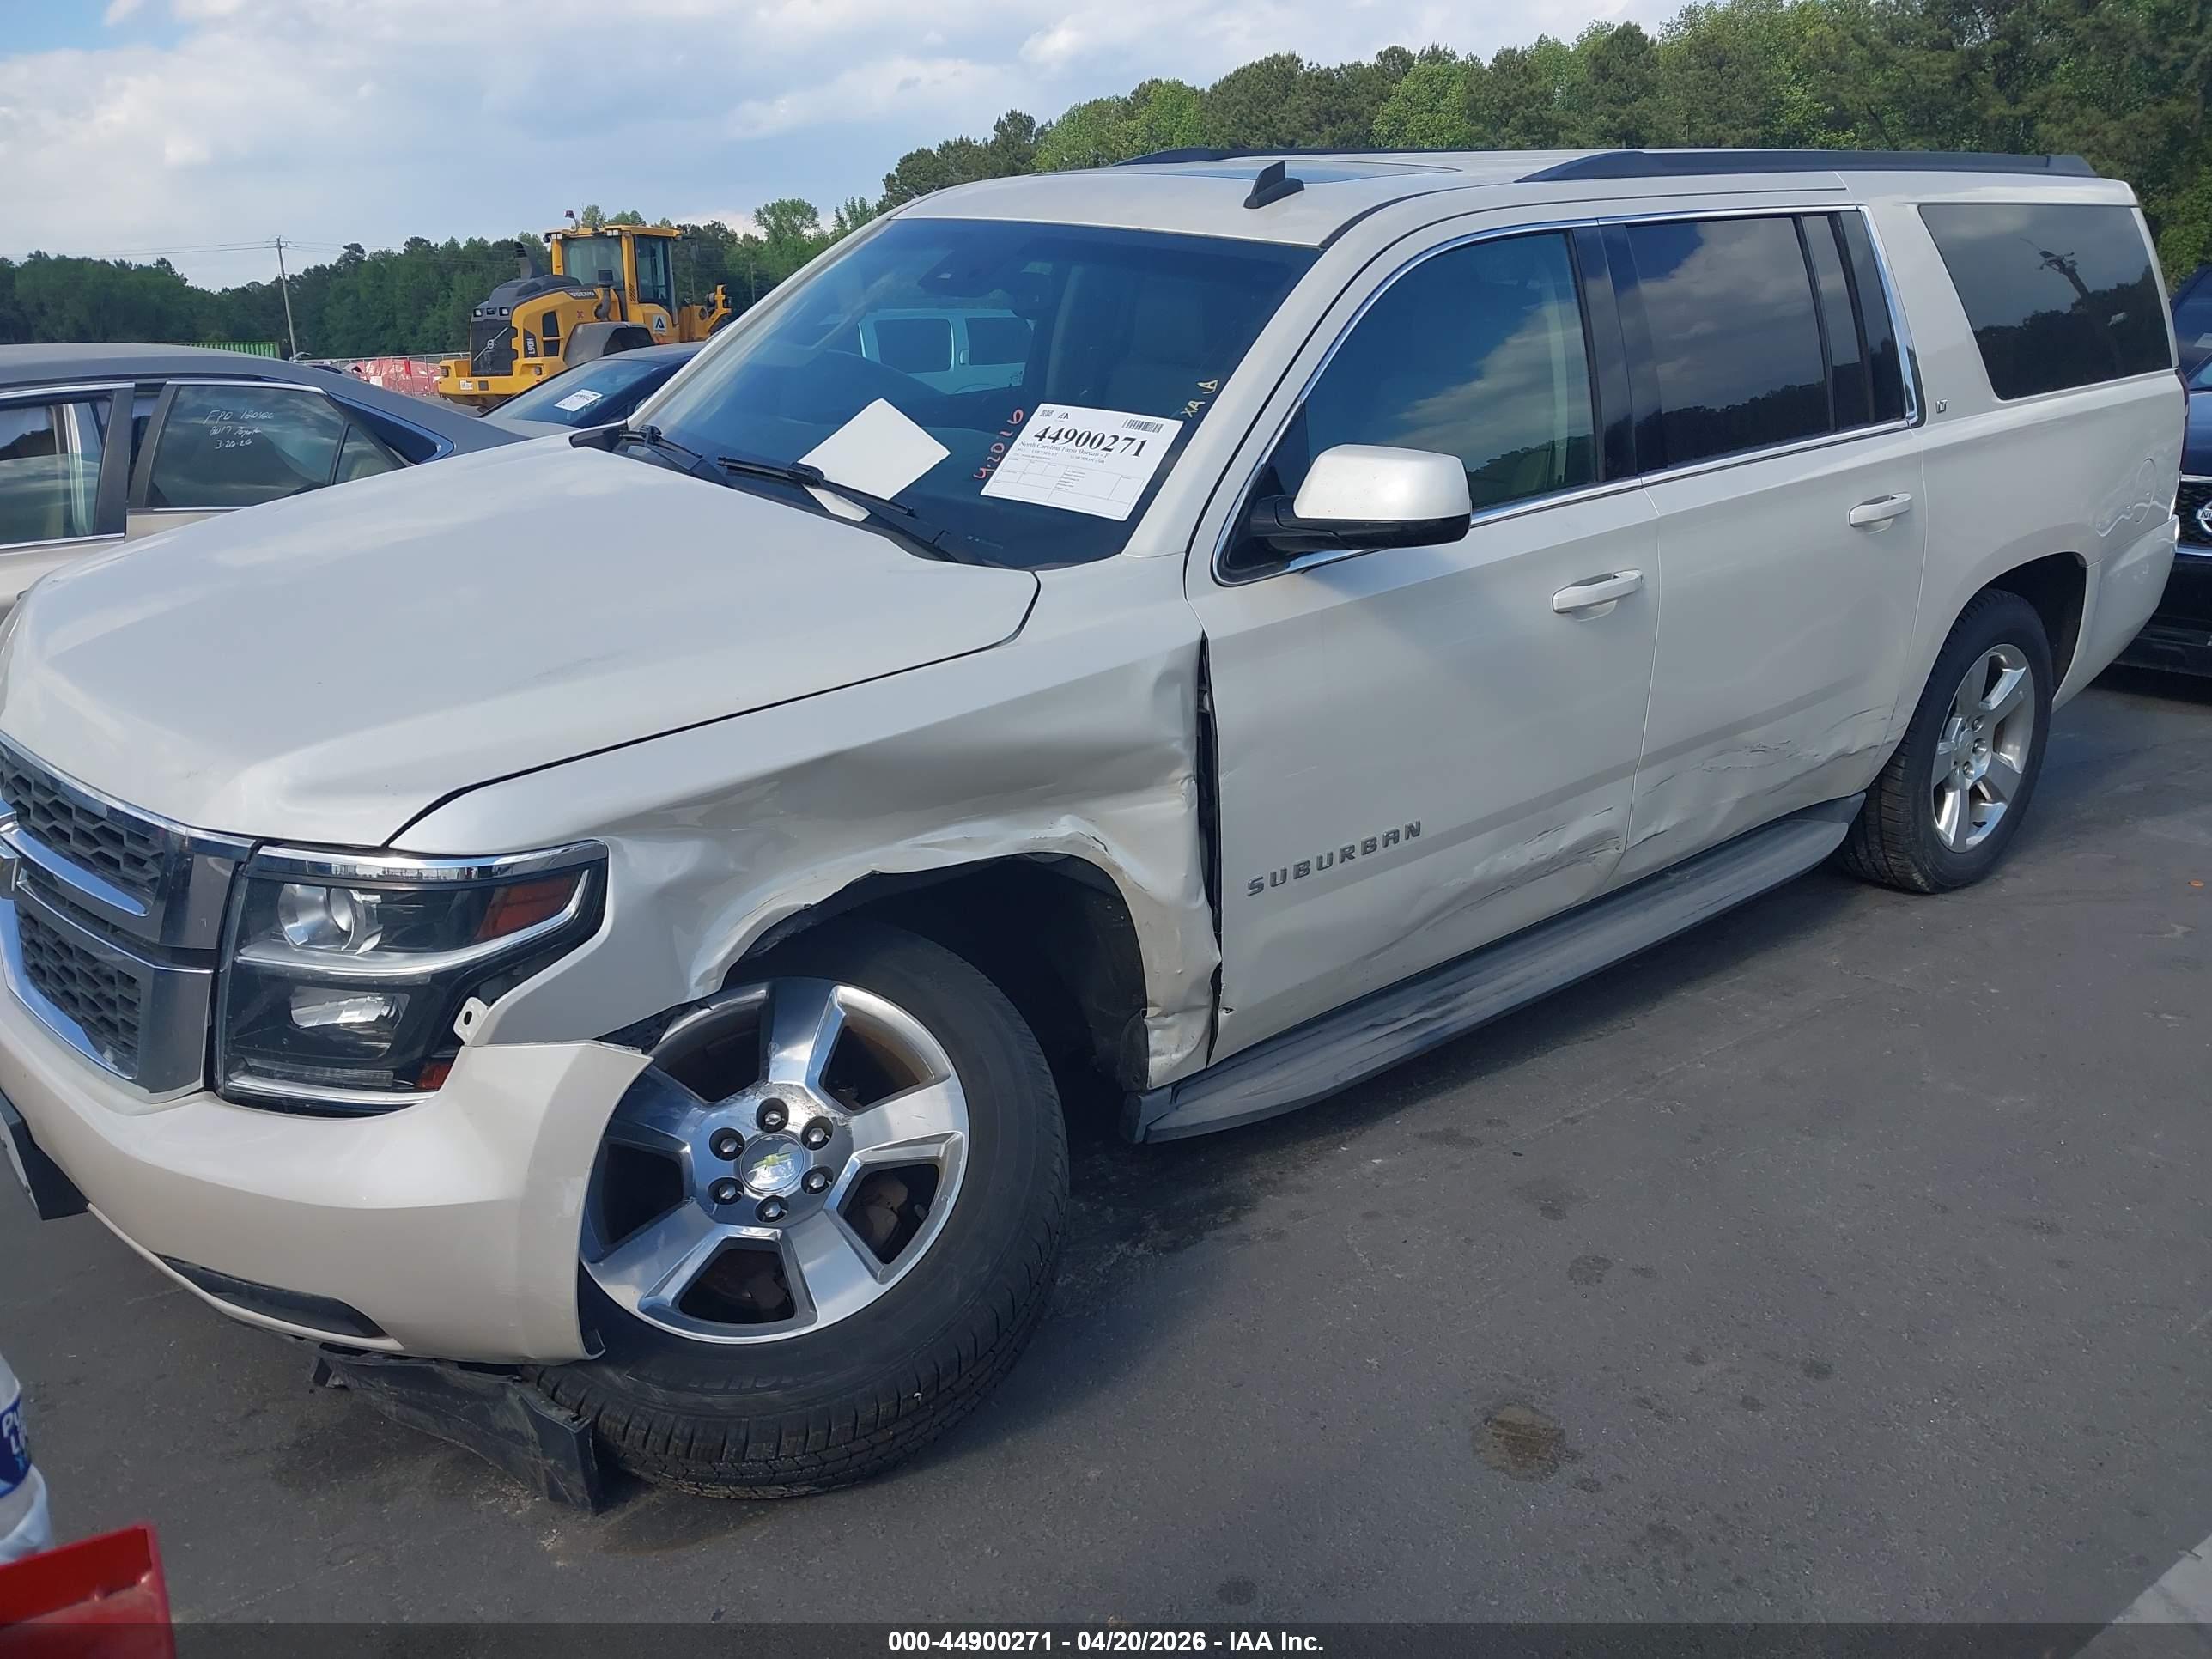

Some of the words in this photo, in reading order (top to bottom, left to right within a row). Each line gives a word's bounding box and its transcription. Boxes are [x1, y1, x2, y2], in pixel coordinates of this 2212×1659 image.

[1936, 398, 1949, 414] LT
[1034, 425, 1148, 458] 44900271
[1246, 819, 1422, 898] SUBURBAN
